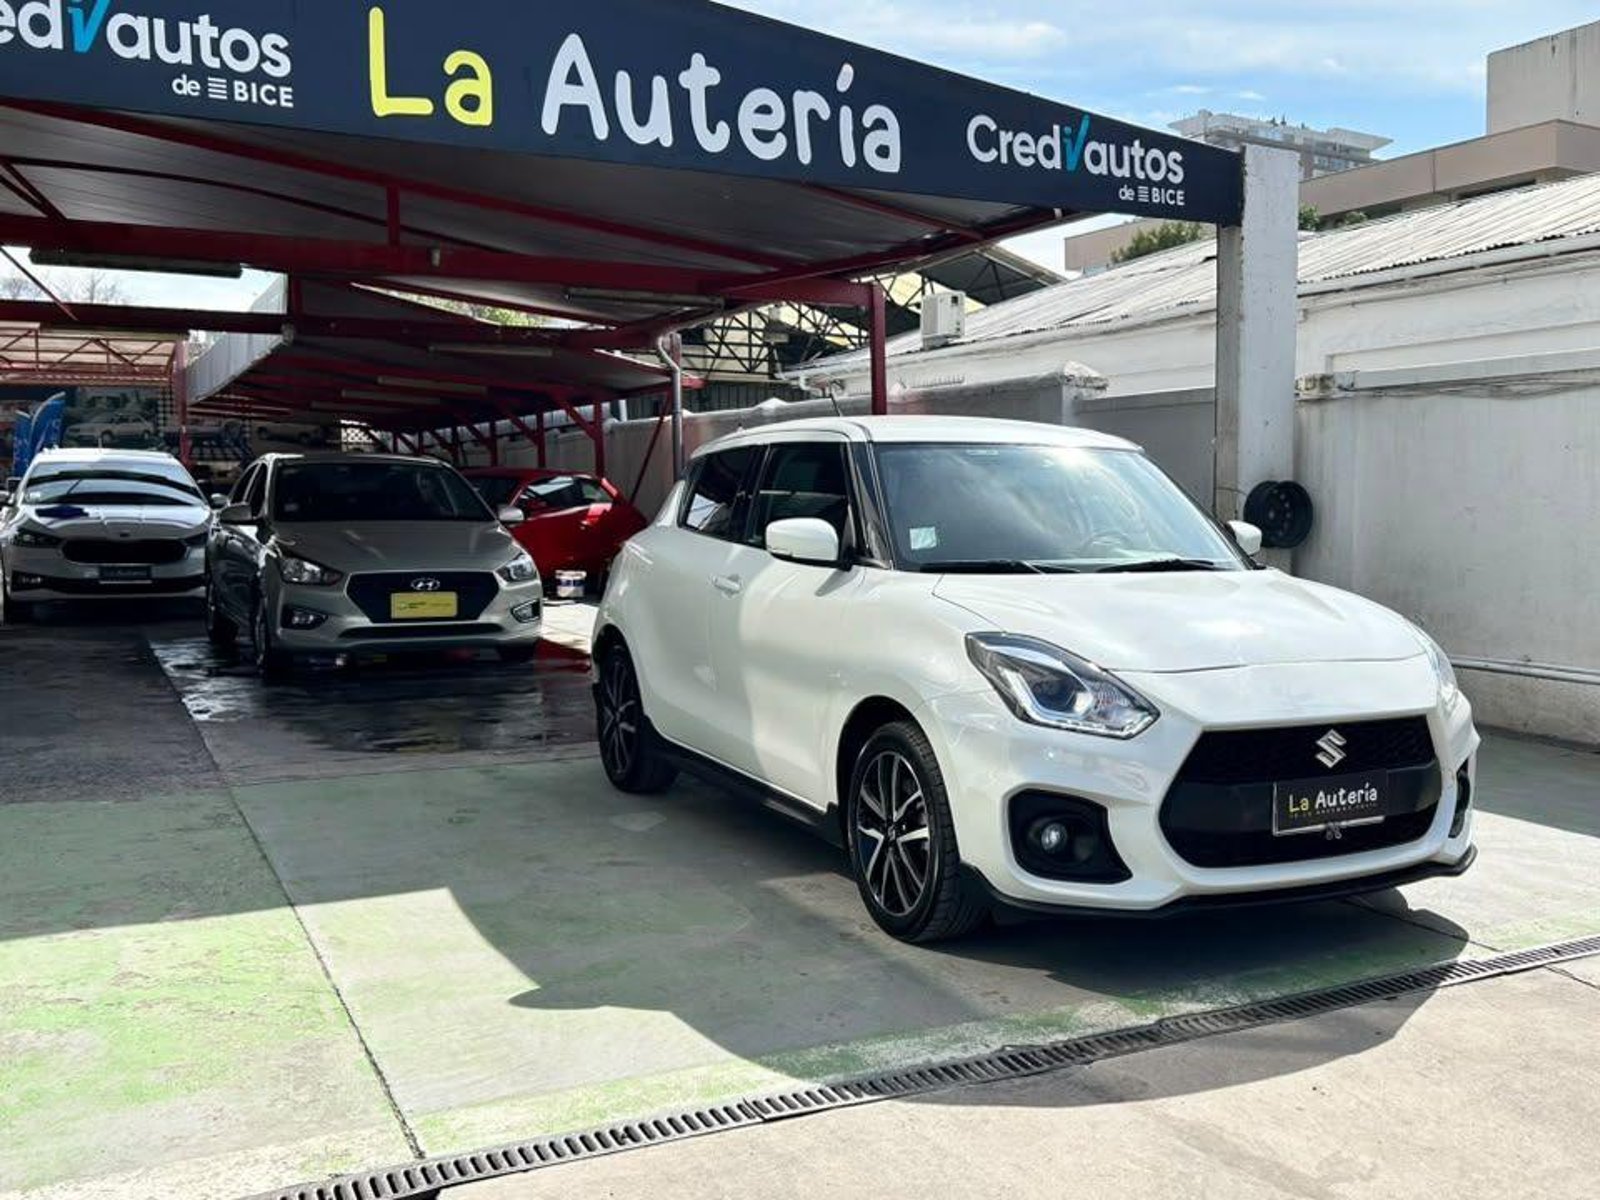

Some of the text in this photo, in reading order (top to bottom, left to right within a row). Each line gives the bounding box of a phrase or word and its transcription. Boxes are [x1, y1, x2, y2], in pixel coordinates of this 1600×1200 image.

[172, 74, 293, 108] de BICE
[369, 6, 900, 173] La Autería
[1119, 184, 1185, 206] de BICE
[1289, 794, 1309, 812] La
[1314, 782, 1378, 809] Autería
